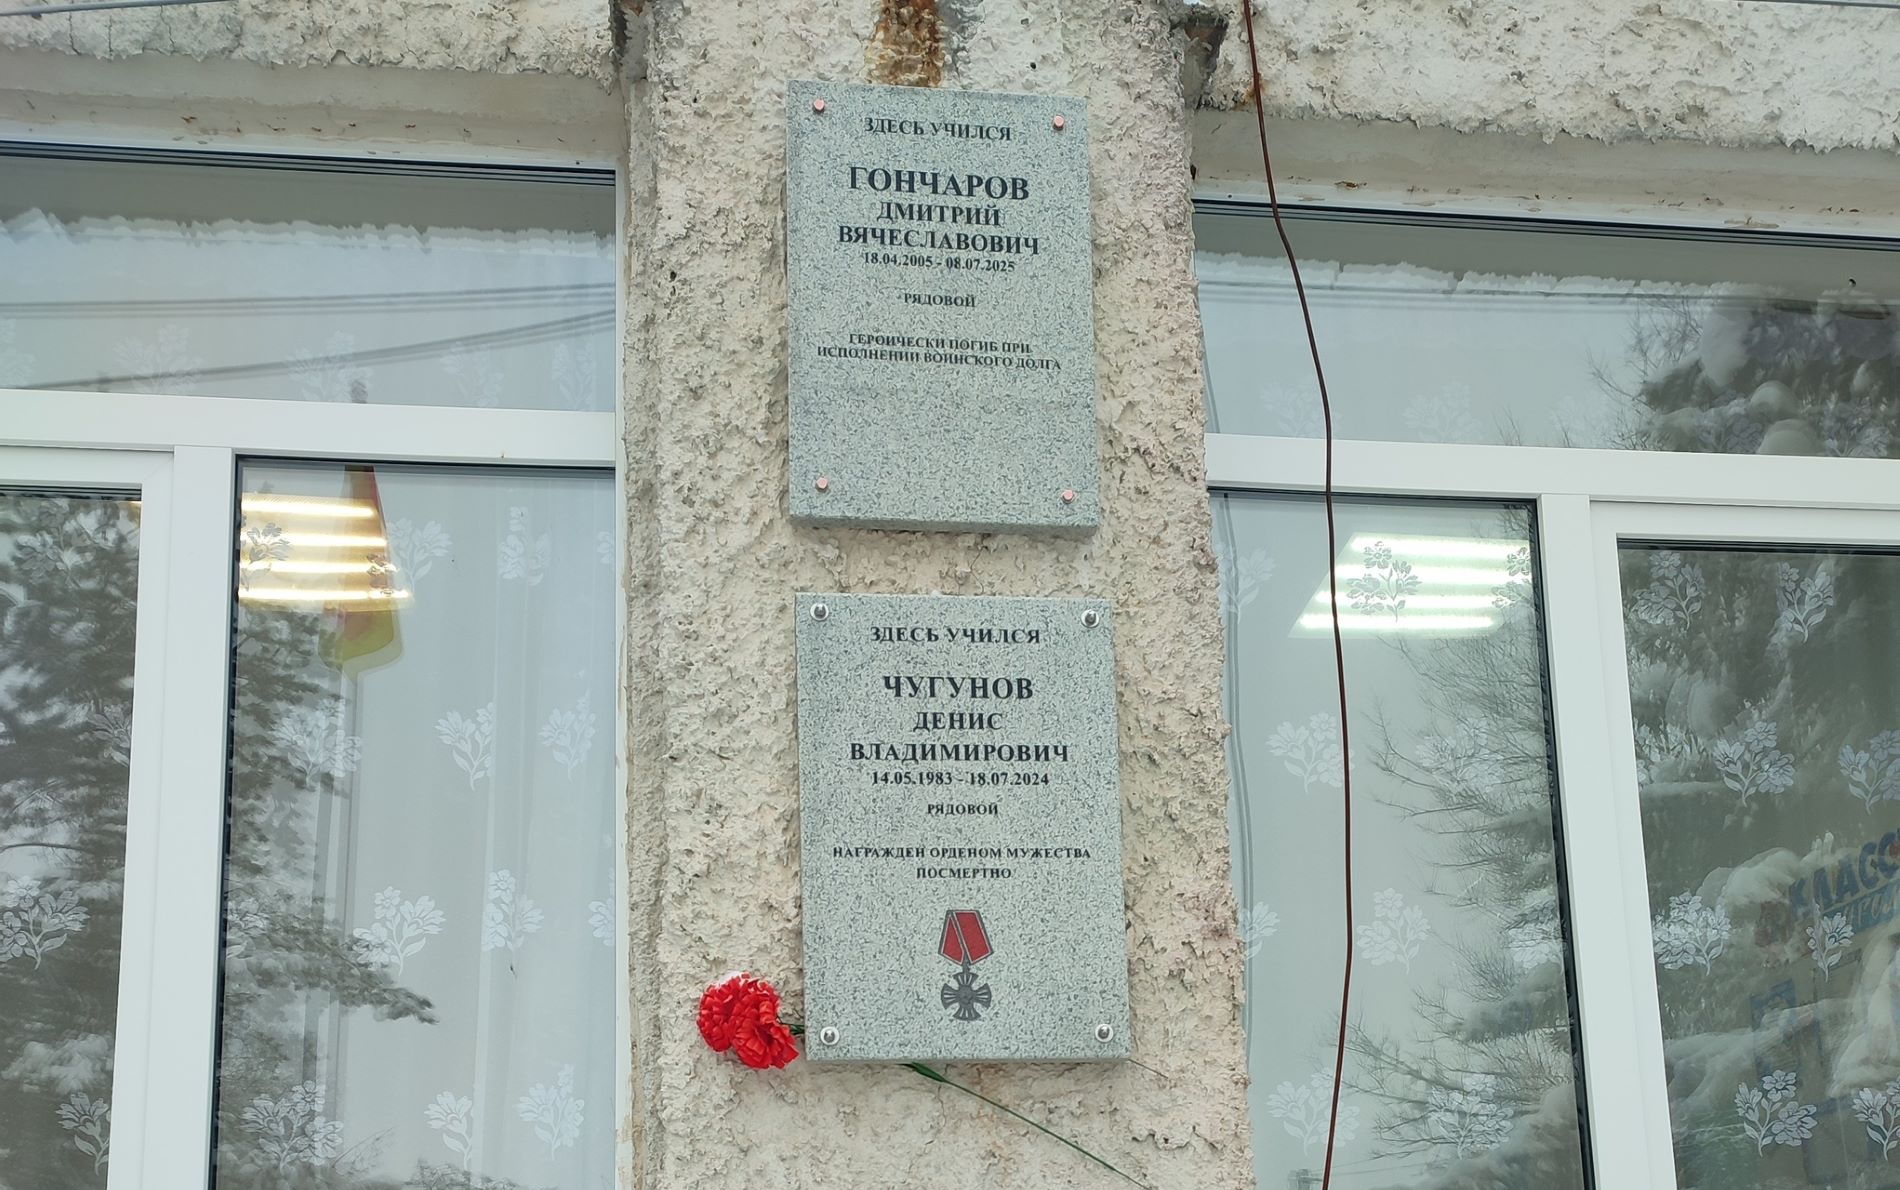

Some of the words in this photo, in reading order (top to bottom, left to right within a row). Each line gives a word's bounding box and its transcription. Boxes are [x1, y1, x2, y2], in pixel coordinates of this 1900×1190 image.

[864, 117, 924, 136] ЗДЕСЬ
[930, 121, 1011, 141] УЧИЛСЯ
[849, 166, 1029, 200] ГОНЧАРОВ
[876, 201, 1001, 226] ДМИТРИЙ
[838, 225, 1040, 255] ВЯЧЕСЛАВОВИЧ
[863, 251, 933, 268] 18.04.2005
[946, 256, 1015, 272] 08.07.2025
[904, 292, 976, 308] РЯДОВОЙ
[849, 333, 945, 349] ГЕРОИЧЕСКИ
[949, 338, 998, 351] ПОГИБ
[1002, 341, 1031, 353] ПРИ
[817, 346, 919, 362] ИСПОЛНЕНИИ
[924, 351, 1013, 368] ВОИНСКОГО
[1016, 356, 1062, 371] ДОЛГА
[870, 627, 939, 643] ЗДЕСЬ
[947, 629, 1040, 644] УЧИЛСЯ
[883, 675, 1034, 700] ЧУГУНОВ
[913, 712, 1004, 731] ДЕНИС
[850, 743, 1069, 765] ВЛАДИМИРОВИЧ
[871, 771, 953, 786] 14.05.1983
[969, 771, 1049, 786] 18.07.2024
[927, 801, 999, 816] РЯДОВОЙ
[833, 847, 925, 860] НАГРАЖДЕН
[930, 847, 1003, 860] ОРДЕНОМ
[1007, 848, 1091, 860] МУЖЕСТВА
[916, 867, 1012, 880] ПОСМЕРТНО
